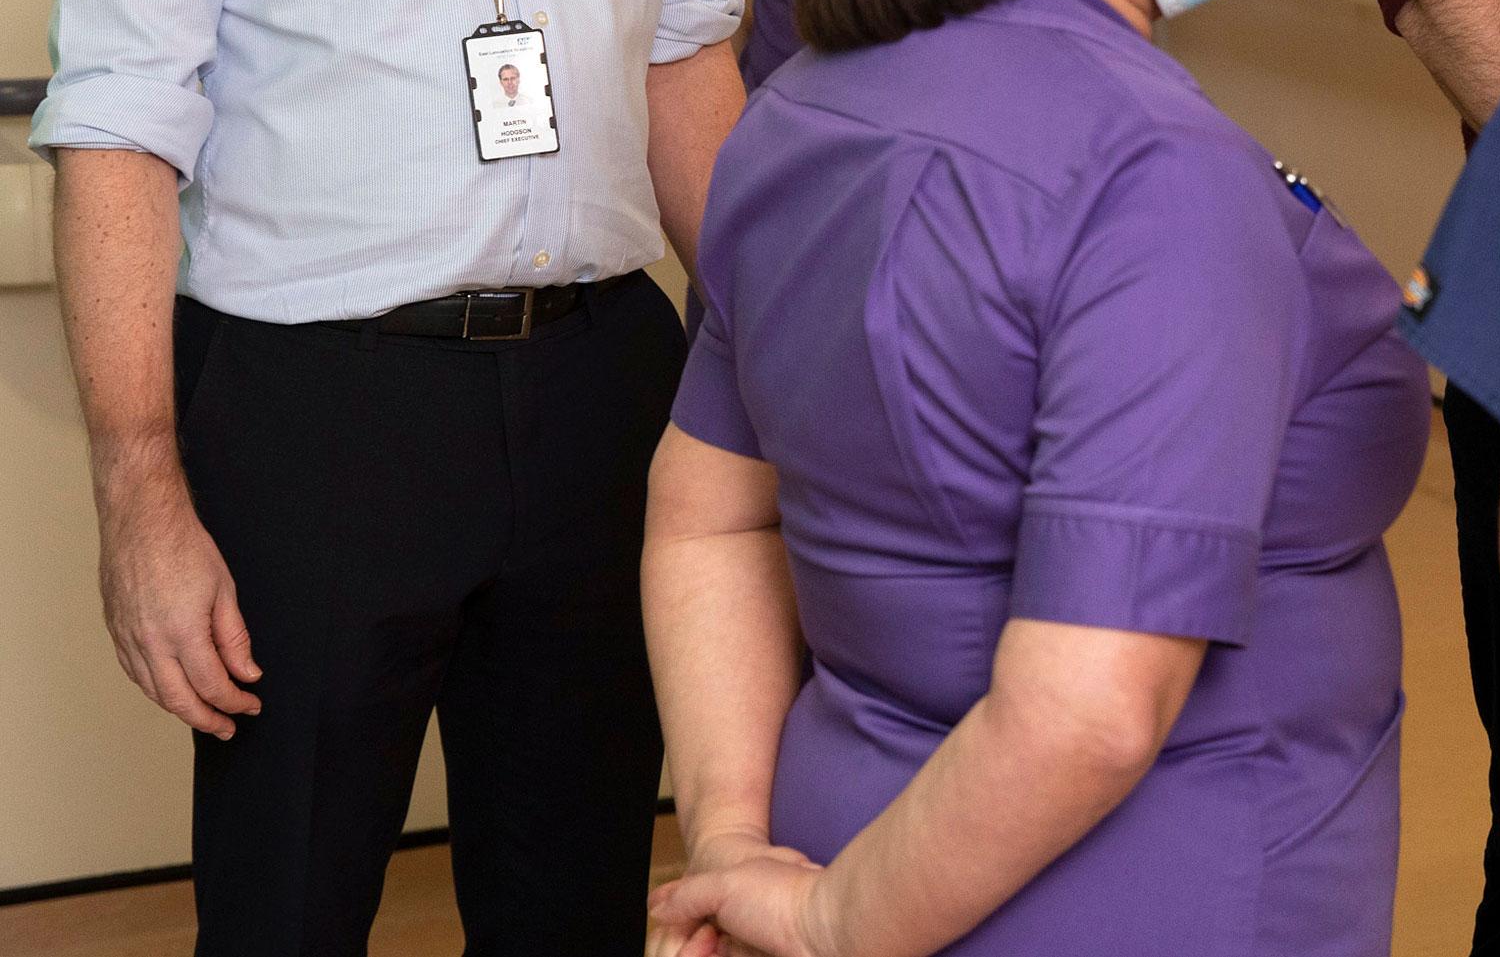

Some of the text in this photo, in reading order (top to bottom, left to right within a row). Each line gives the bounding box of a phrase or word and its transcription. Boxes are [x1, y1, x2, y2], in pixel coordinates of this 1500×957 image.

[503, 119, 527, 127] MARTIN
[500, 128, 532, 137] HODGSON
[495, 134, 540, 145] CHIEF EXECUTIVE
